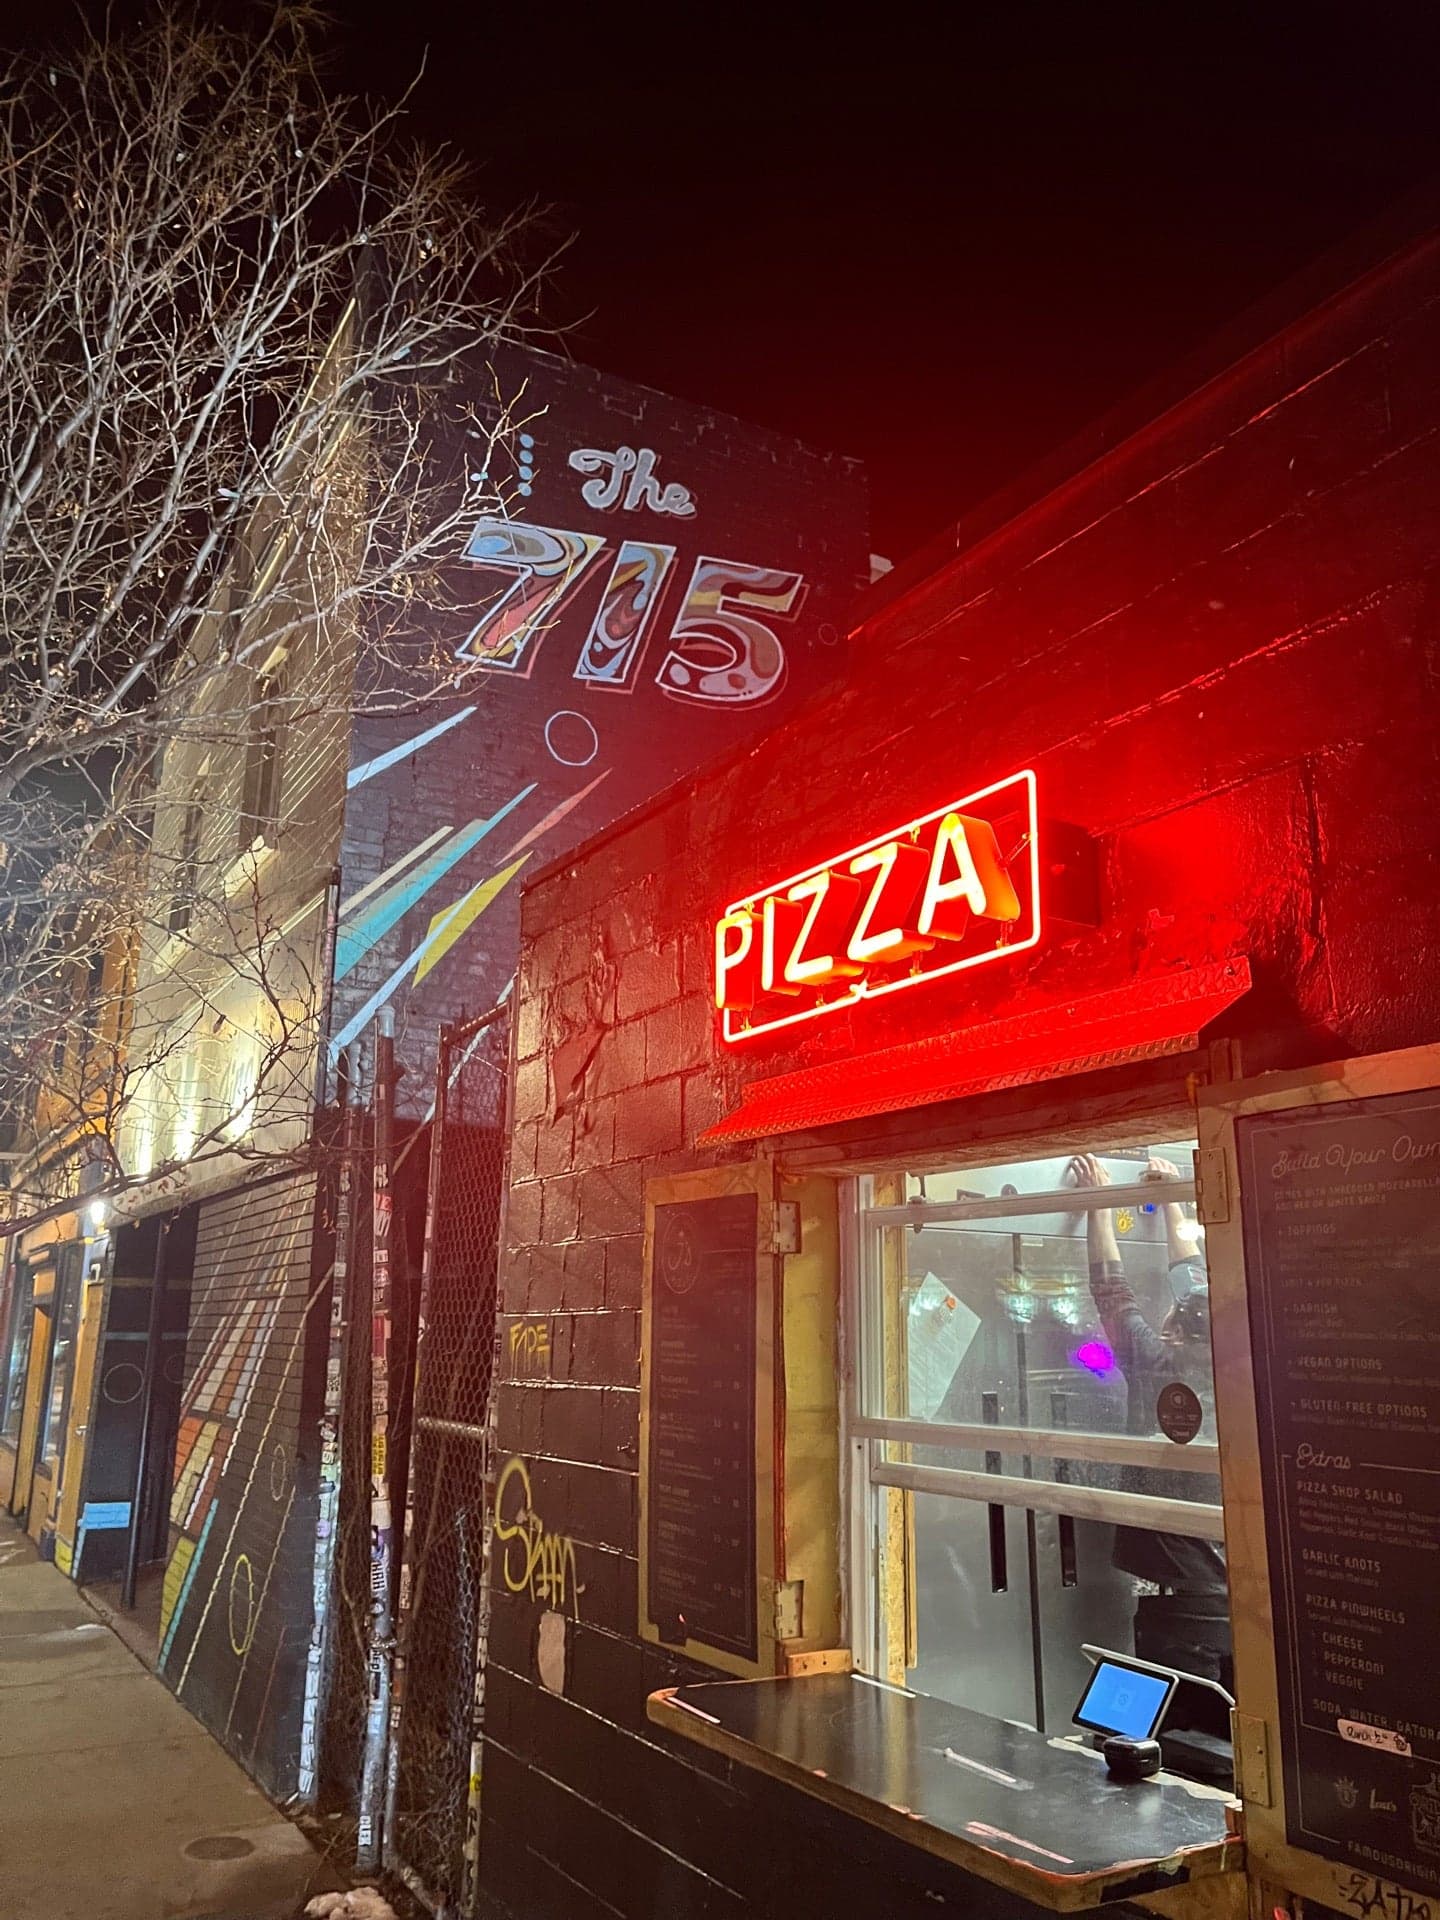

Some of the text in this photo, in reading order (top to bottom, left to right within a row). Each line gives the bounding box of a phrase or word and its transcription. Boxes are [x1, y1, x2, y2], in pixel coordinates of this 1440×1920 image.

[569, 446, 697, 517] The
[455, 516, 807, 706] 715
[715, 812, 1003, 1010] PIZZA
[1272, 1150, 1321, 1179] Build
[1325, 1143, 1386, 1176] Your
[1287, 1223, 1337, 1236] TOPPINGS
[1299, 1356, 1382, 1370] VEGAN OPTIONS
[1377, 1402, 1428, 1419] OPTIONS
[1296, 1442, 1351, 1470] Extras
[1297, 1480, 1403, 1505] PIZZA SHOP SALAD
[1302, 1548, 1381, 1574] GARLIC KNOTS
[1306, 1593, 1337, 1610] PIZZA
[1341, 1600, 1406, 1625] PINWHEELS
[1322, 1631, 1365, 1651] CHEESE
[1323, 1651, 1385, 1675] PEPPERONI
[1325, 1671, 1365, 1690] VEGGIE
